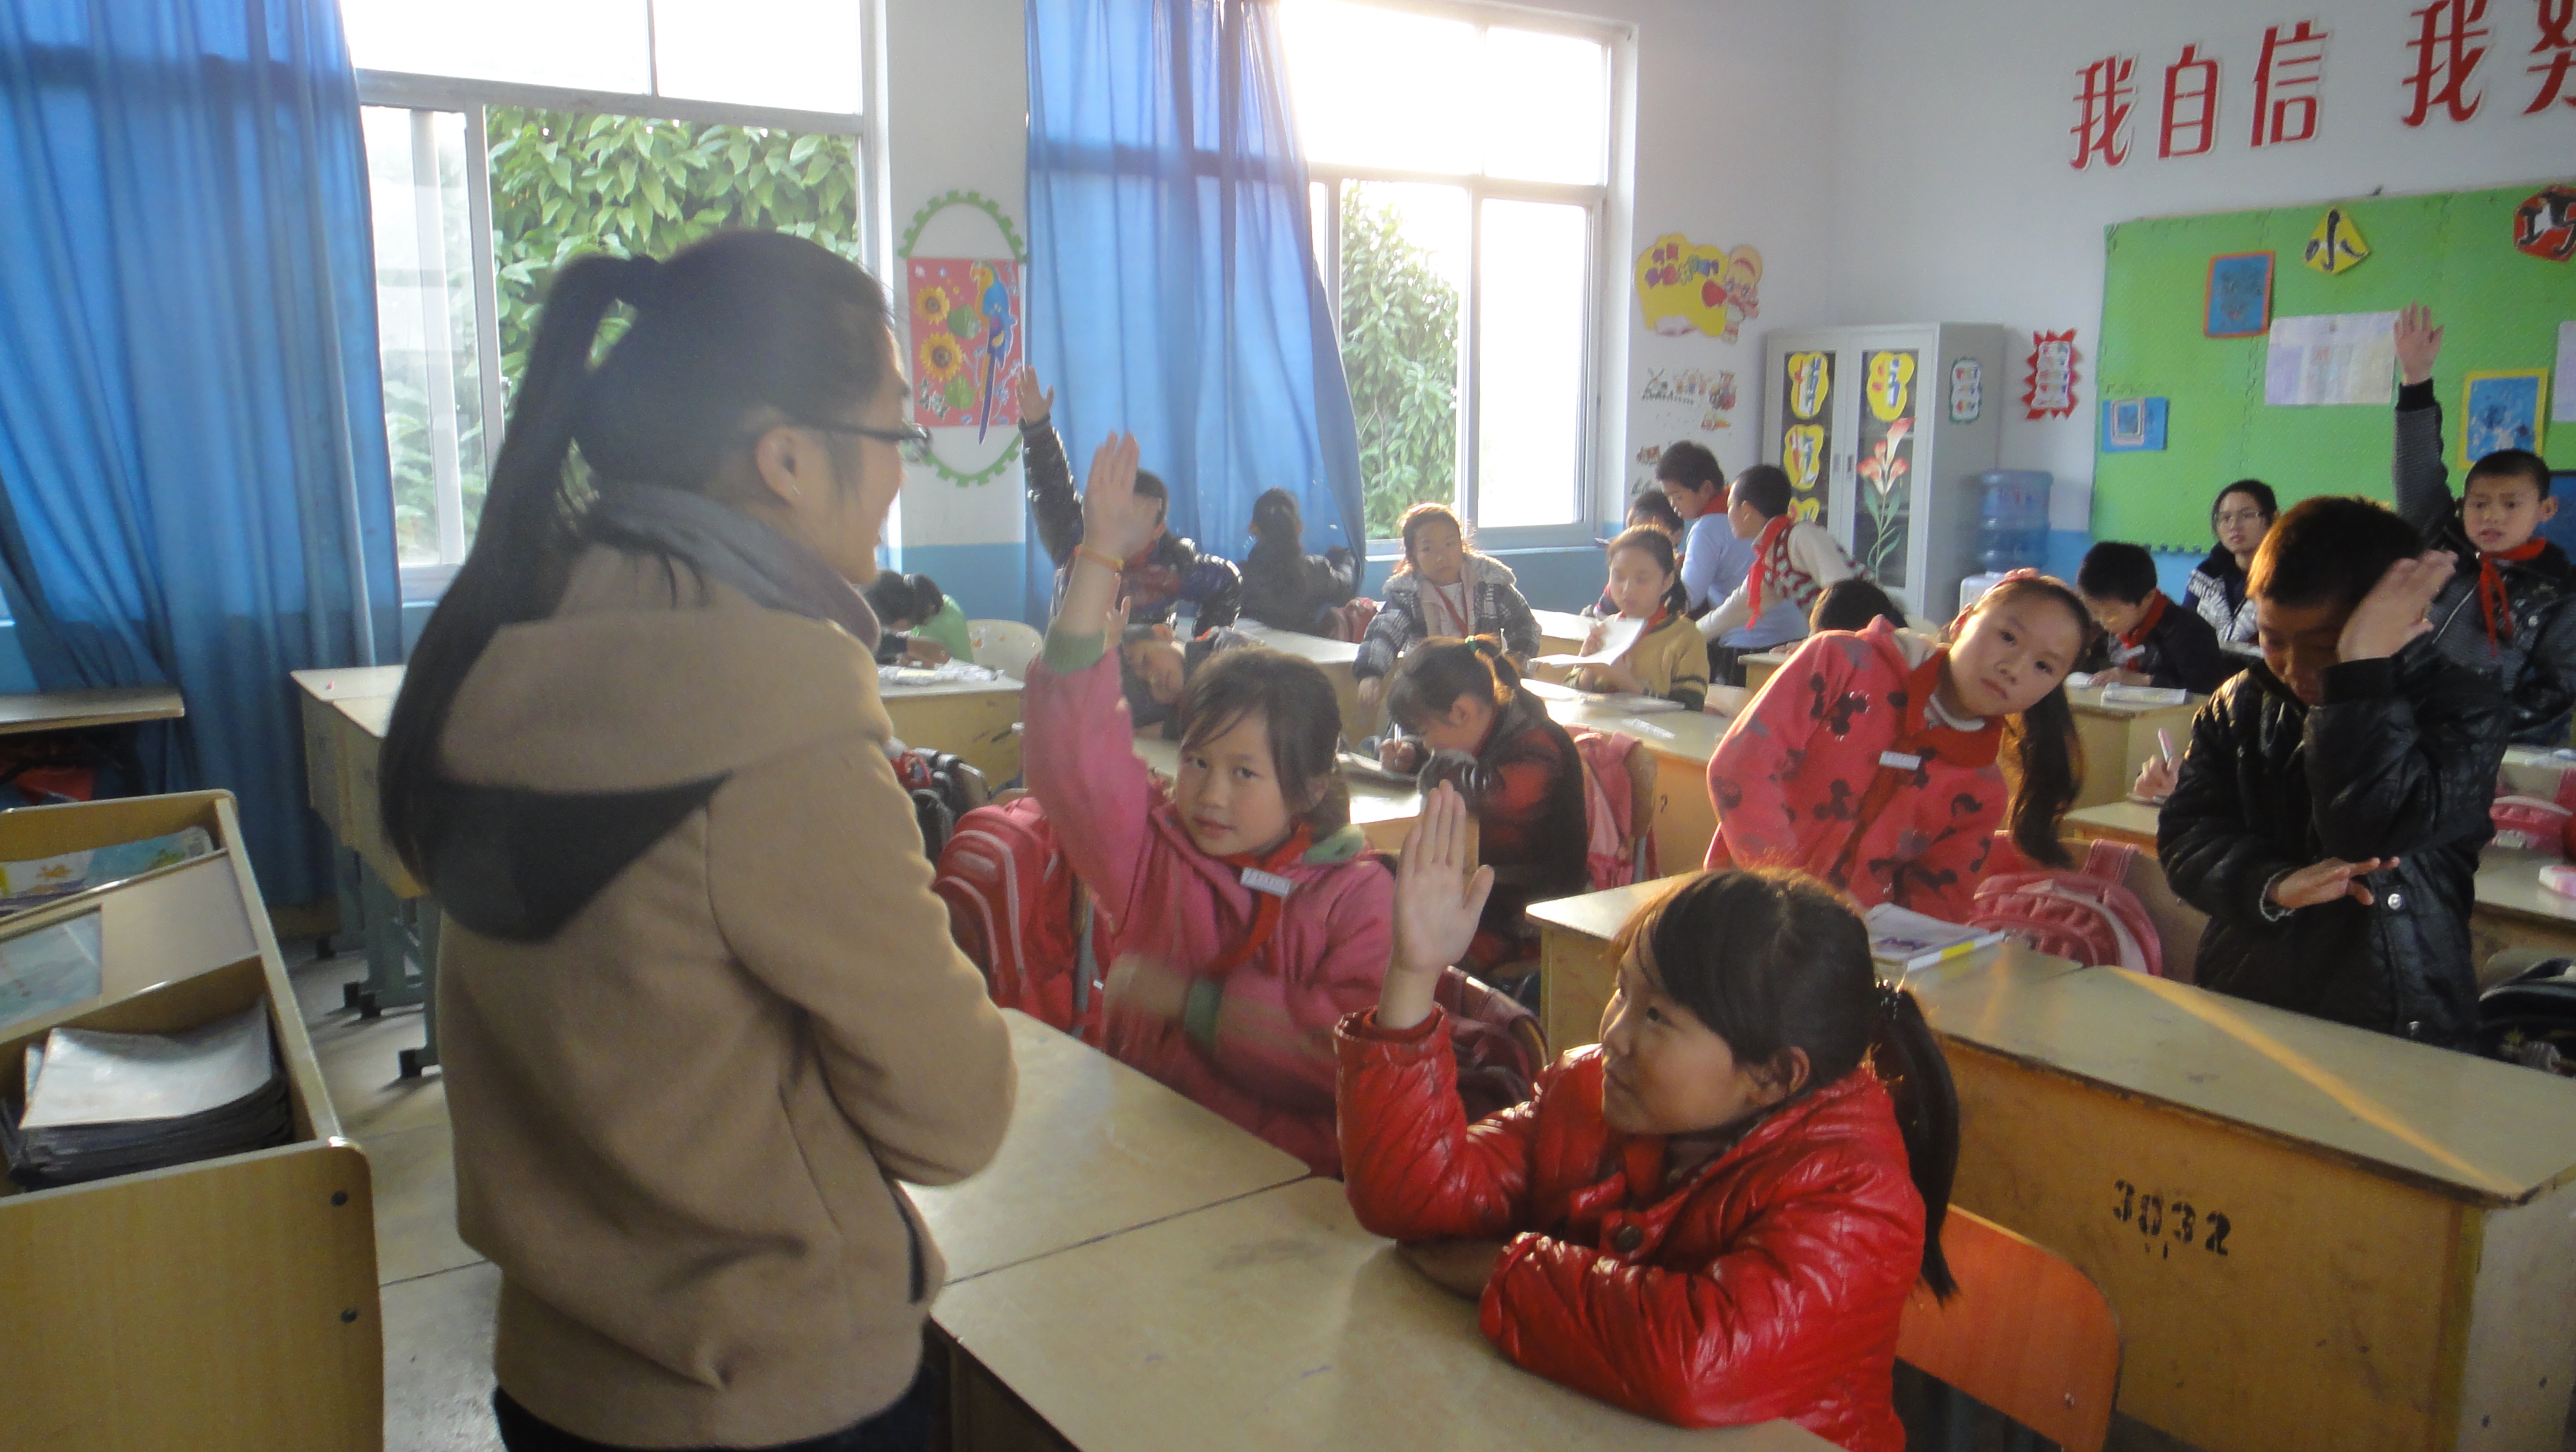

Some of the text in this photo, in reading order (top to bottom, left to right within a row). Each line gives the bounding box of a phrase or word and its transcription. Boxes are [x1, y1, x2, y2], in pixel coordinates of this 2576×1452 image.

[2070, 20, 2328, 170] 我自信
[2304, 209, 2366, 272] 小
[2113, 1179, 2231, 1256] 3032
